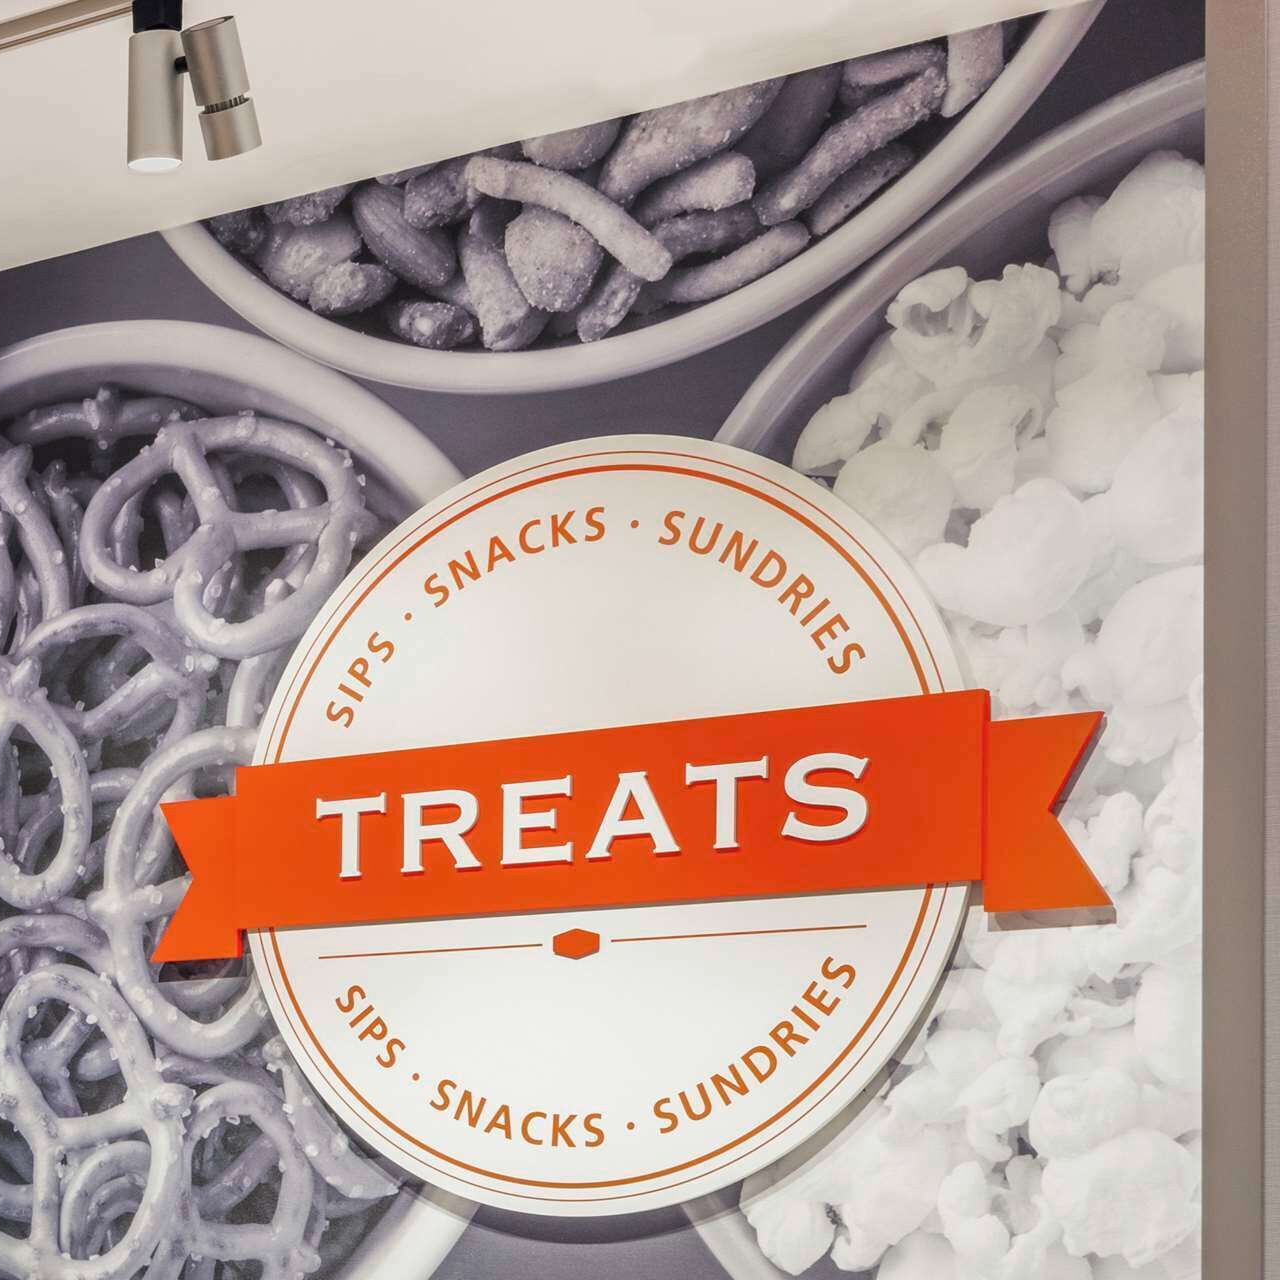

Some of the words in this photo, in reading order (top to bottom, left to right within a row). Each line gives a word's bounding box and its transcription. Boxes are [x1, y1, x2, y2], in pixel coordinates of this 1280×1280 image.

[326, 631, 395, 728] SIPS
[423, 506, 606, 608] SNACKS
[658, 510, 867, 675] SUNDRIES
[315, 752, 872, 879] TREATS
[335, 984, 406, 1069] SIPS
[429, 1078, 605, 1148] SNACKS
[652, 956, 857, 1135] SUNDRIES
